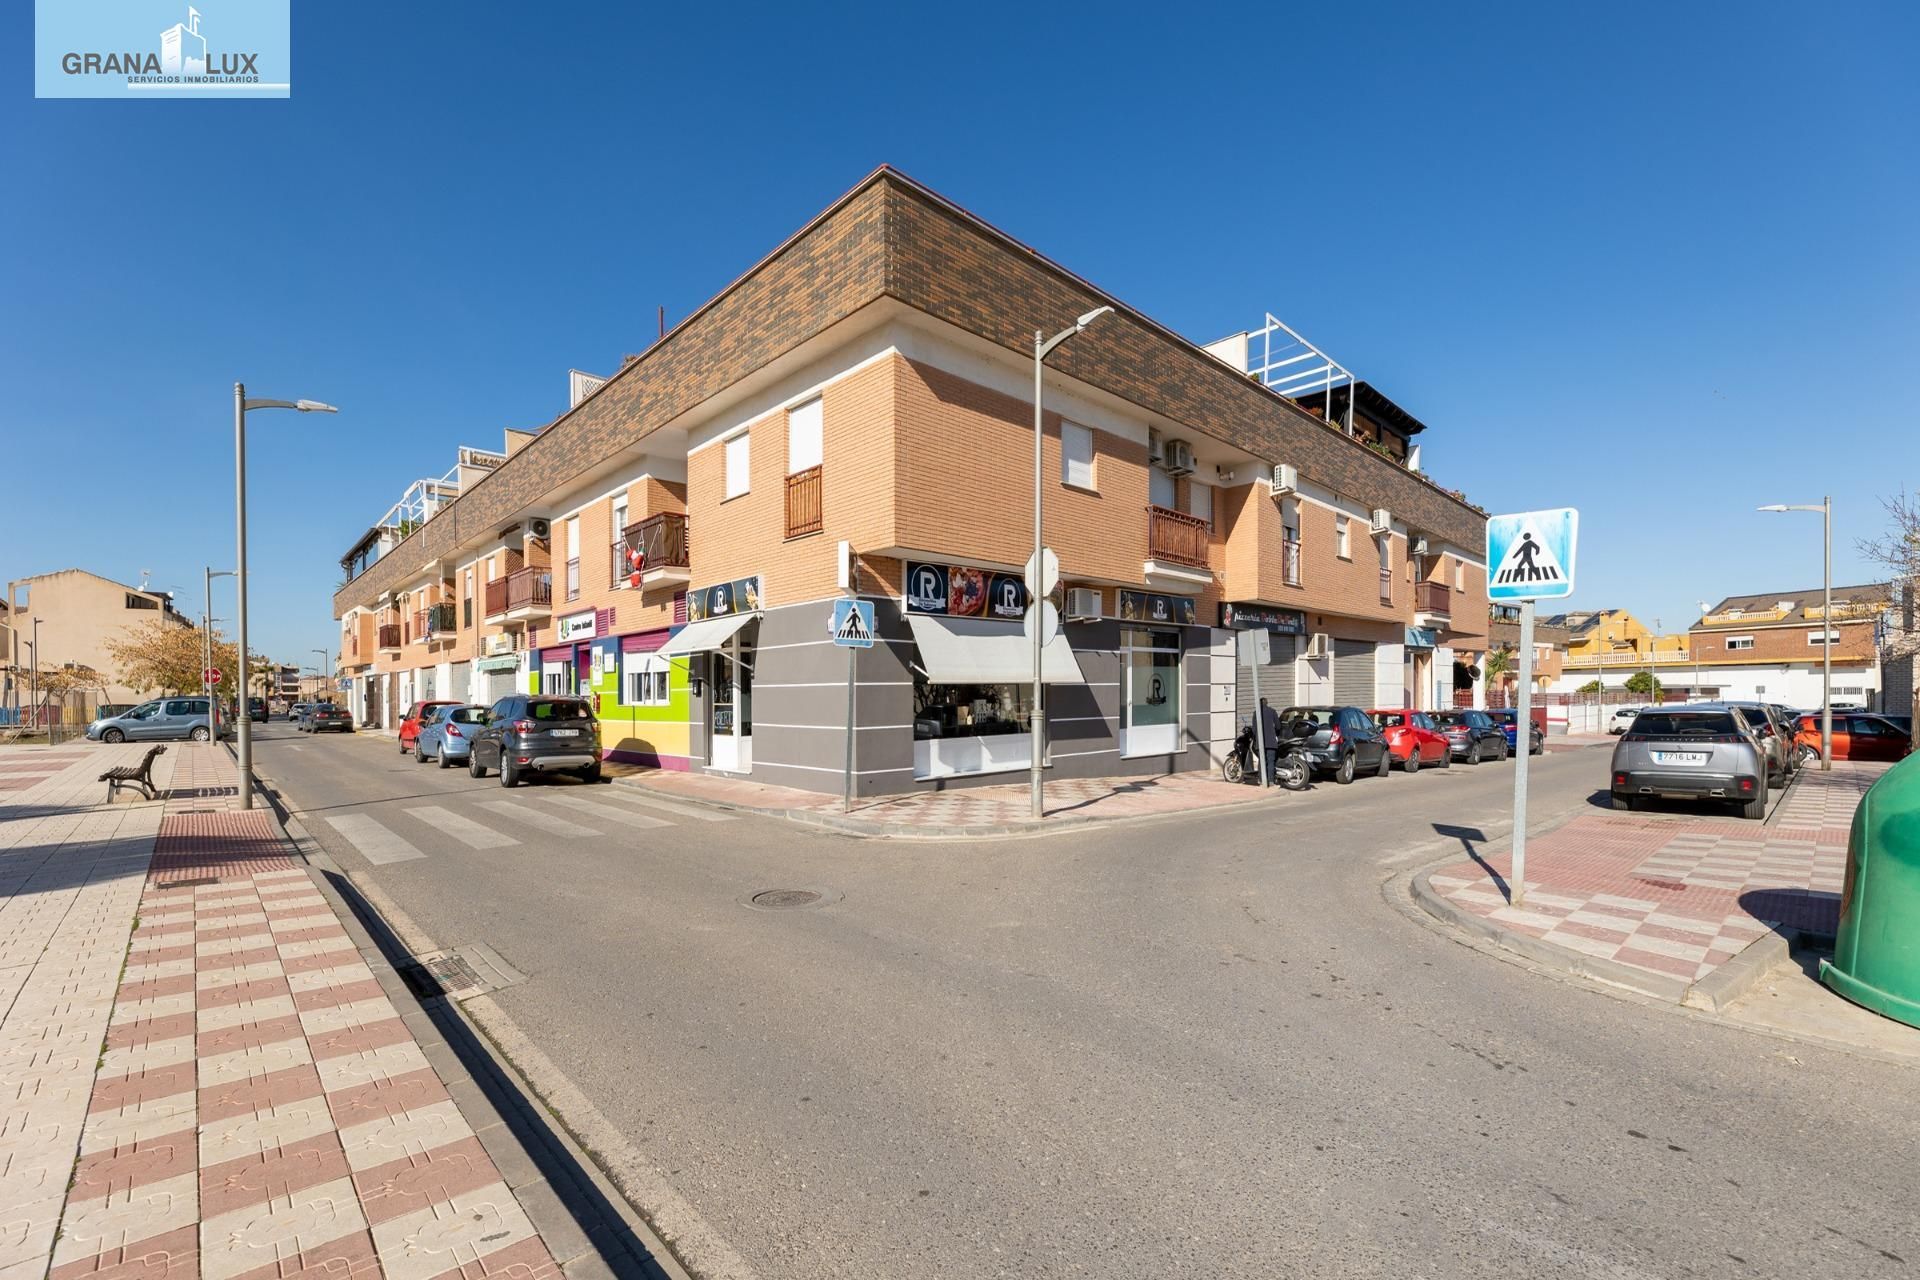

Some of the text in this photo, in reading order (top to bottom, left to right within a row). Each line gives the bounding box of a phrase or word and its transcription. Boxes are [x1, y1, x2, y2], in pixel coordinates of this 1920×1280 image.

[920, 571, 936, 600] R
[1003, 584, 1016, 607] R
[1152, 679, 1162, 699] R
